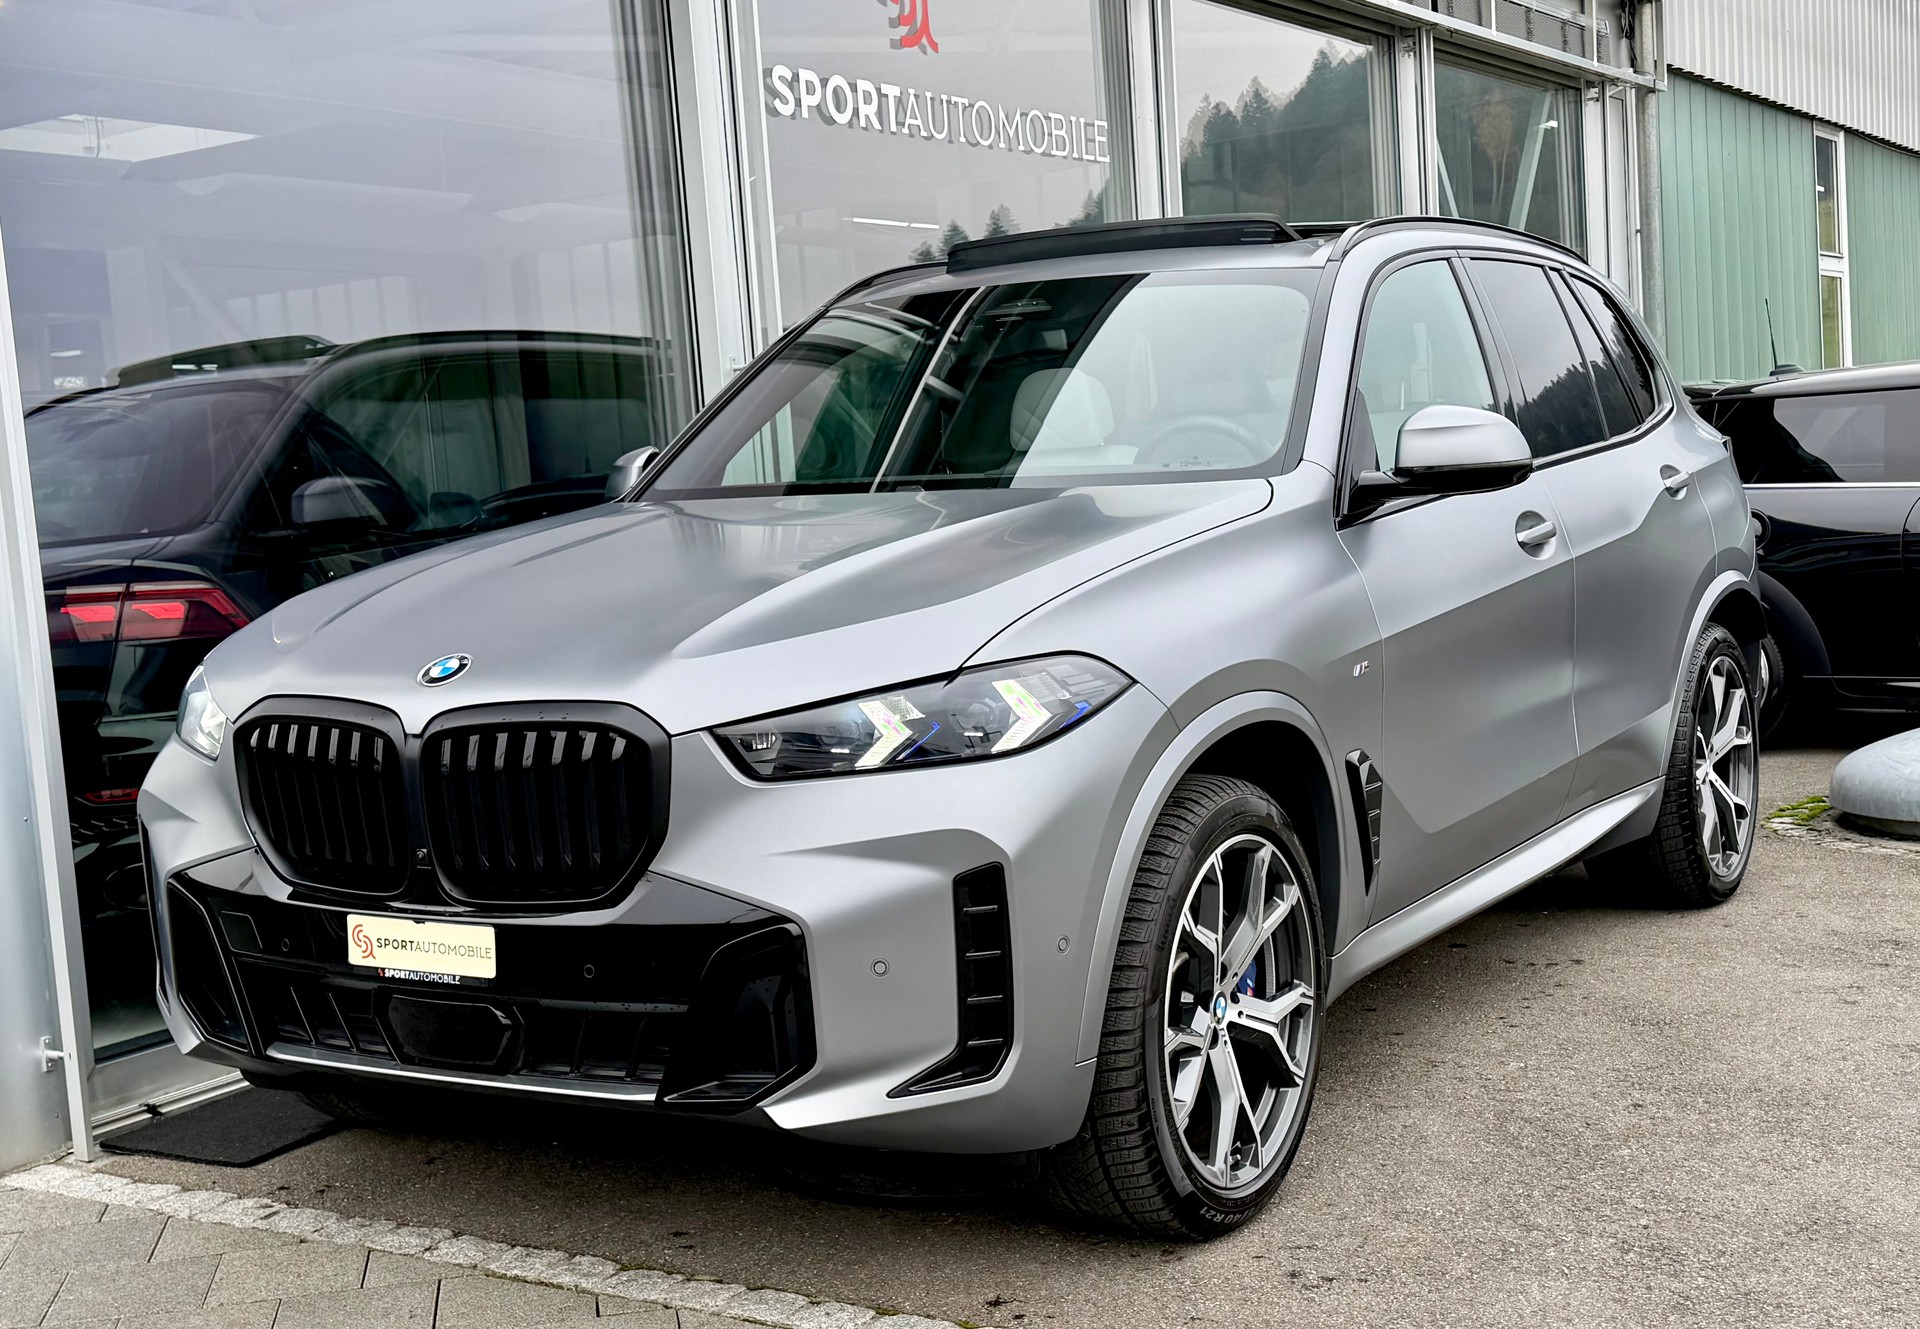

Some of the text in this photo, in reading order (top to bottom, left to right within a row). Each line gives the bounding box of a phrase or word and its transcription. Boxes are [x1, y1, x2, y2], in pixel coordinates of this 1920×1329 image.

[771, 64, 1110, 163] SPORTAUTOMOBILE
[376, 937, 492, 960] SPORTAUTOMOBILE
[384, 968, 460, 984] SPORTAUTOMOBILE
